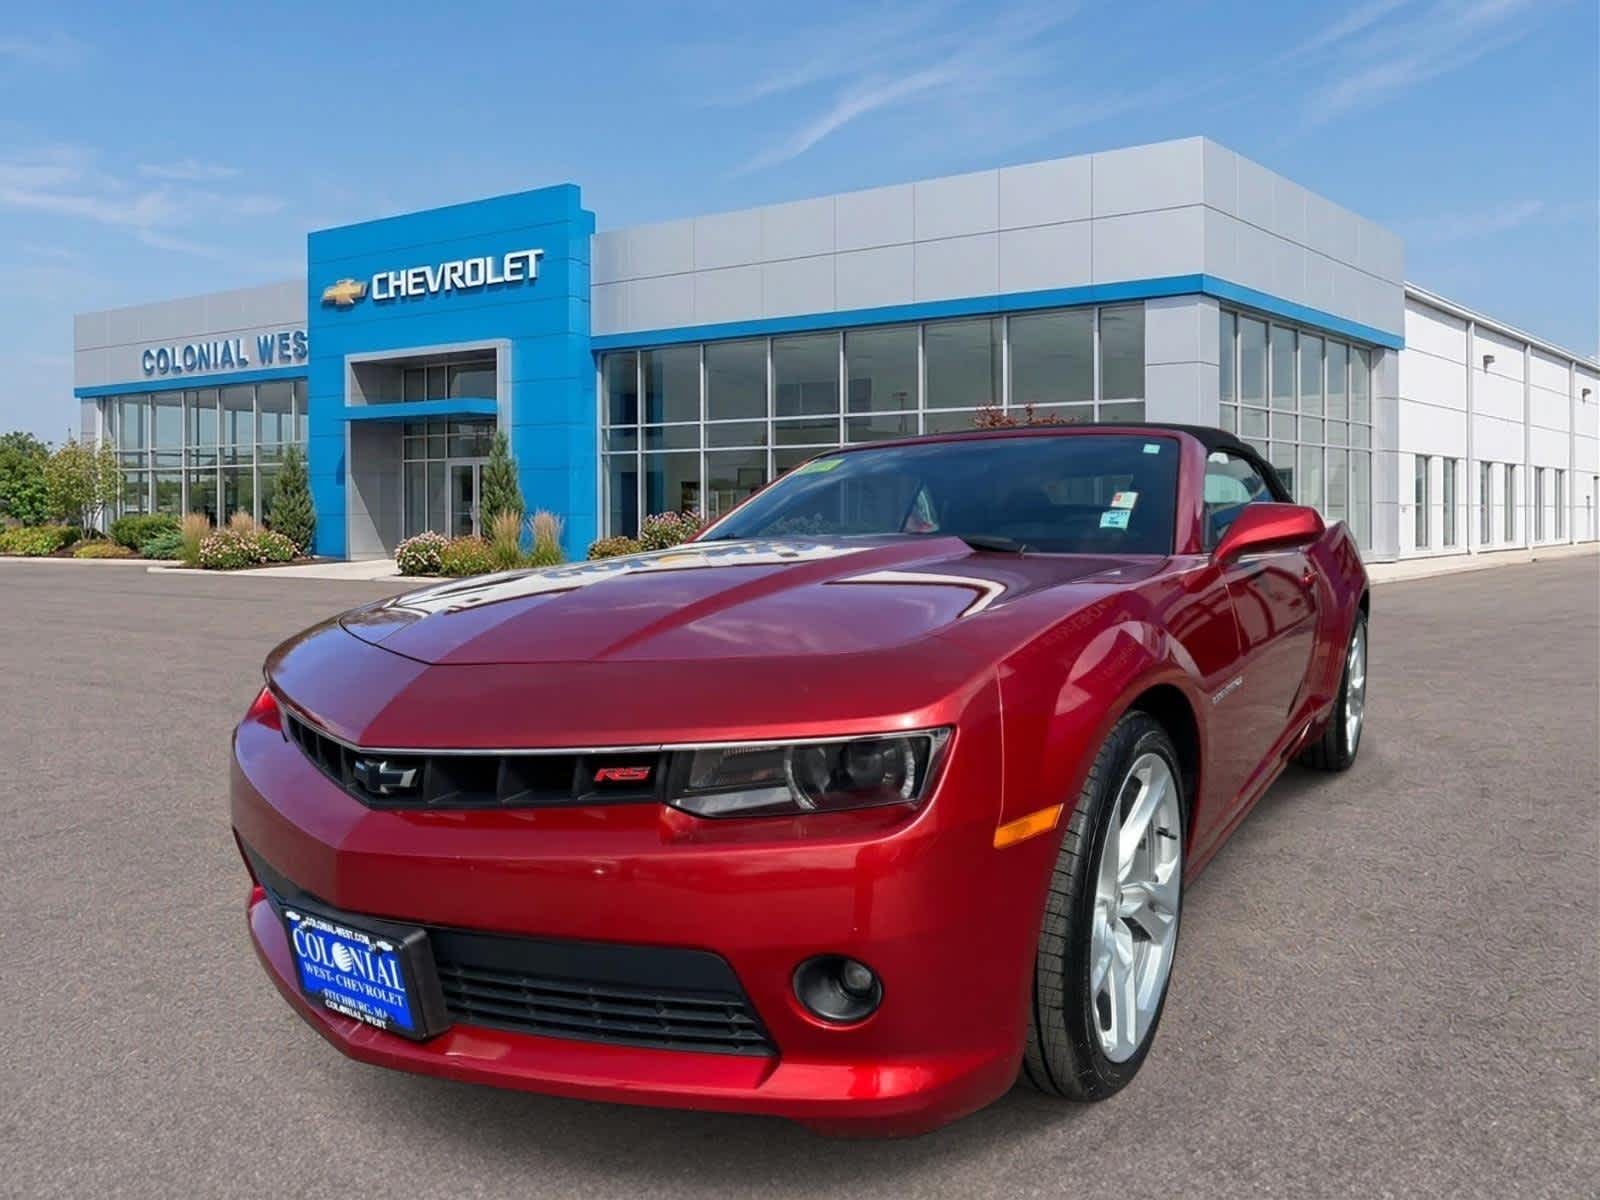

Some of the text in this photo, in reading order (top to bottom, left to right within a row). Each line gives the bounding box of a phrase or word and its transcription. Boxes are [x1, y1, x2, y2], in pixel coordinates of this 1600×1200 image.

[372, 249, 544, 300] CHEVROLET
[142, 338, 249, 375] COLONIAL
[594, 766, 650, 781] RS
[293, 927, 406, 992] COLONIAL
